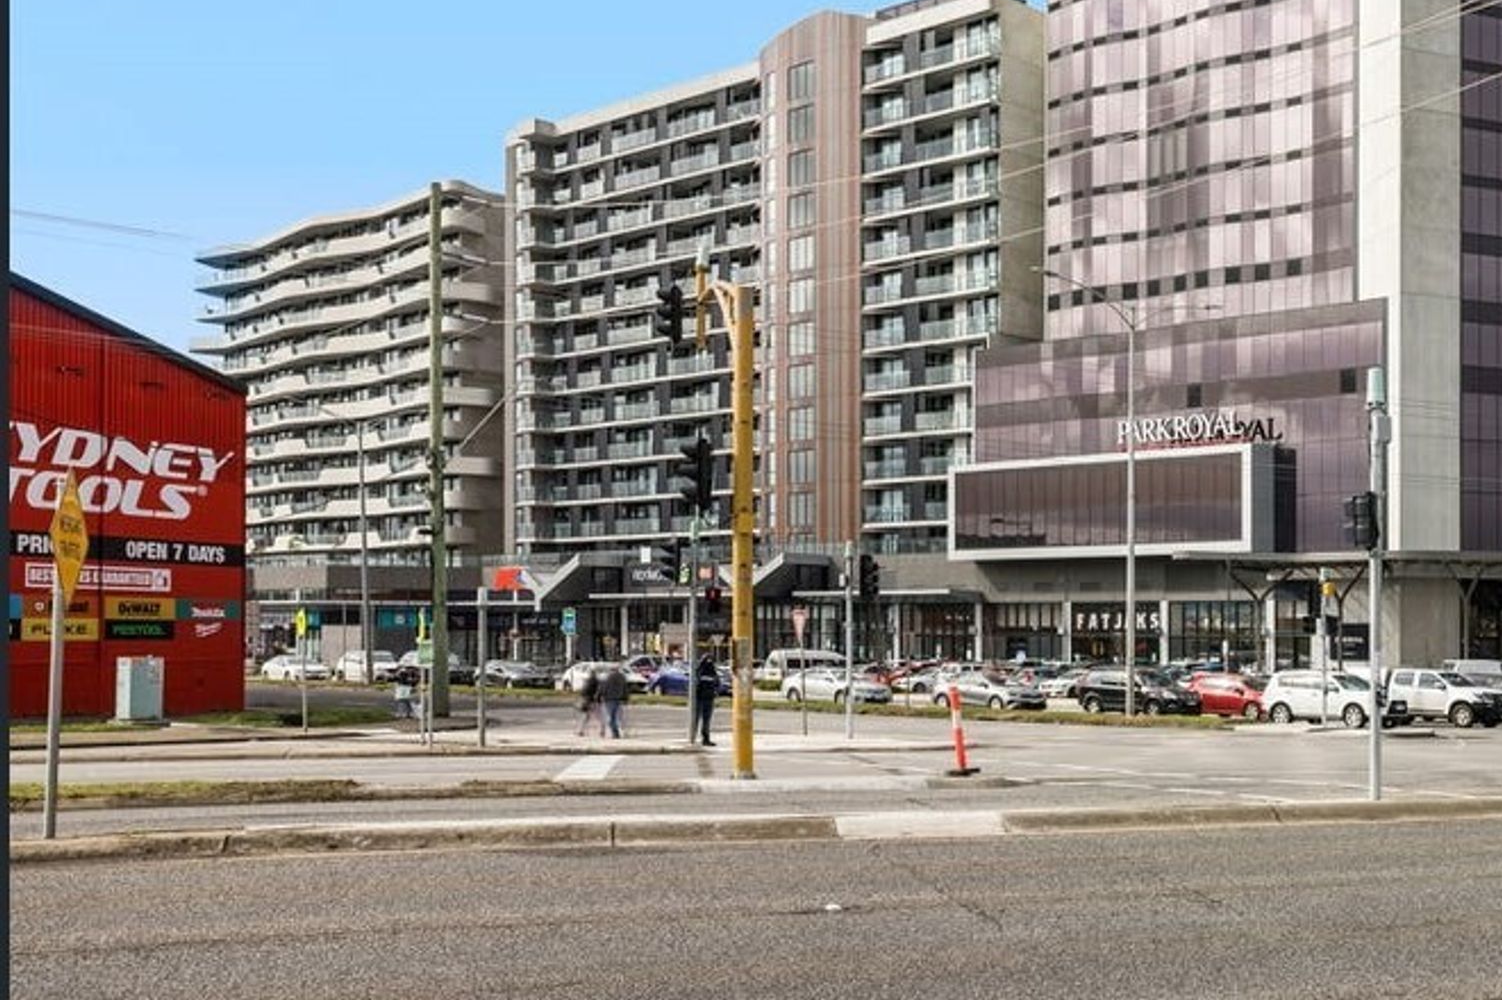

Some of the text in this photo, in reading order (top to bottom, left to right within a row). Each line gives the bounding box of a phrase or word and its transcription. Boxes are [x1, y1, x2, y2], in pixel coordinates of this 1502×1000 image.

[1117, 410, 1244, 445] PARKROYAL
[10, 421, 235, 482] YDNEY
[125, 541, 226, 563] OPEN 7 DAYS
[31, 624, 88, 635] FLKE
